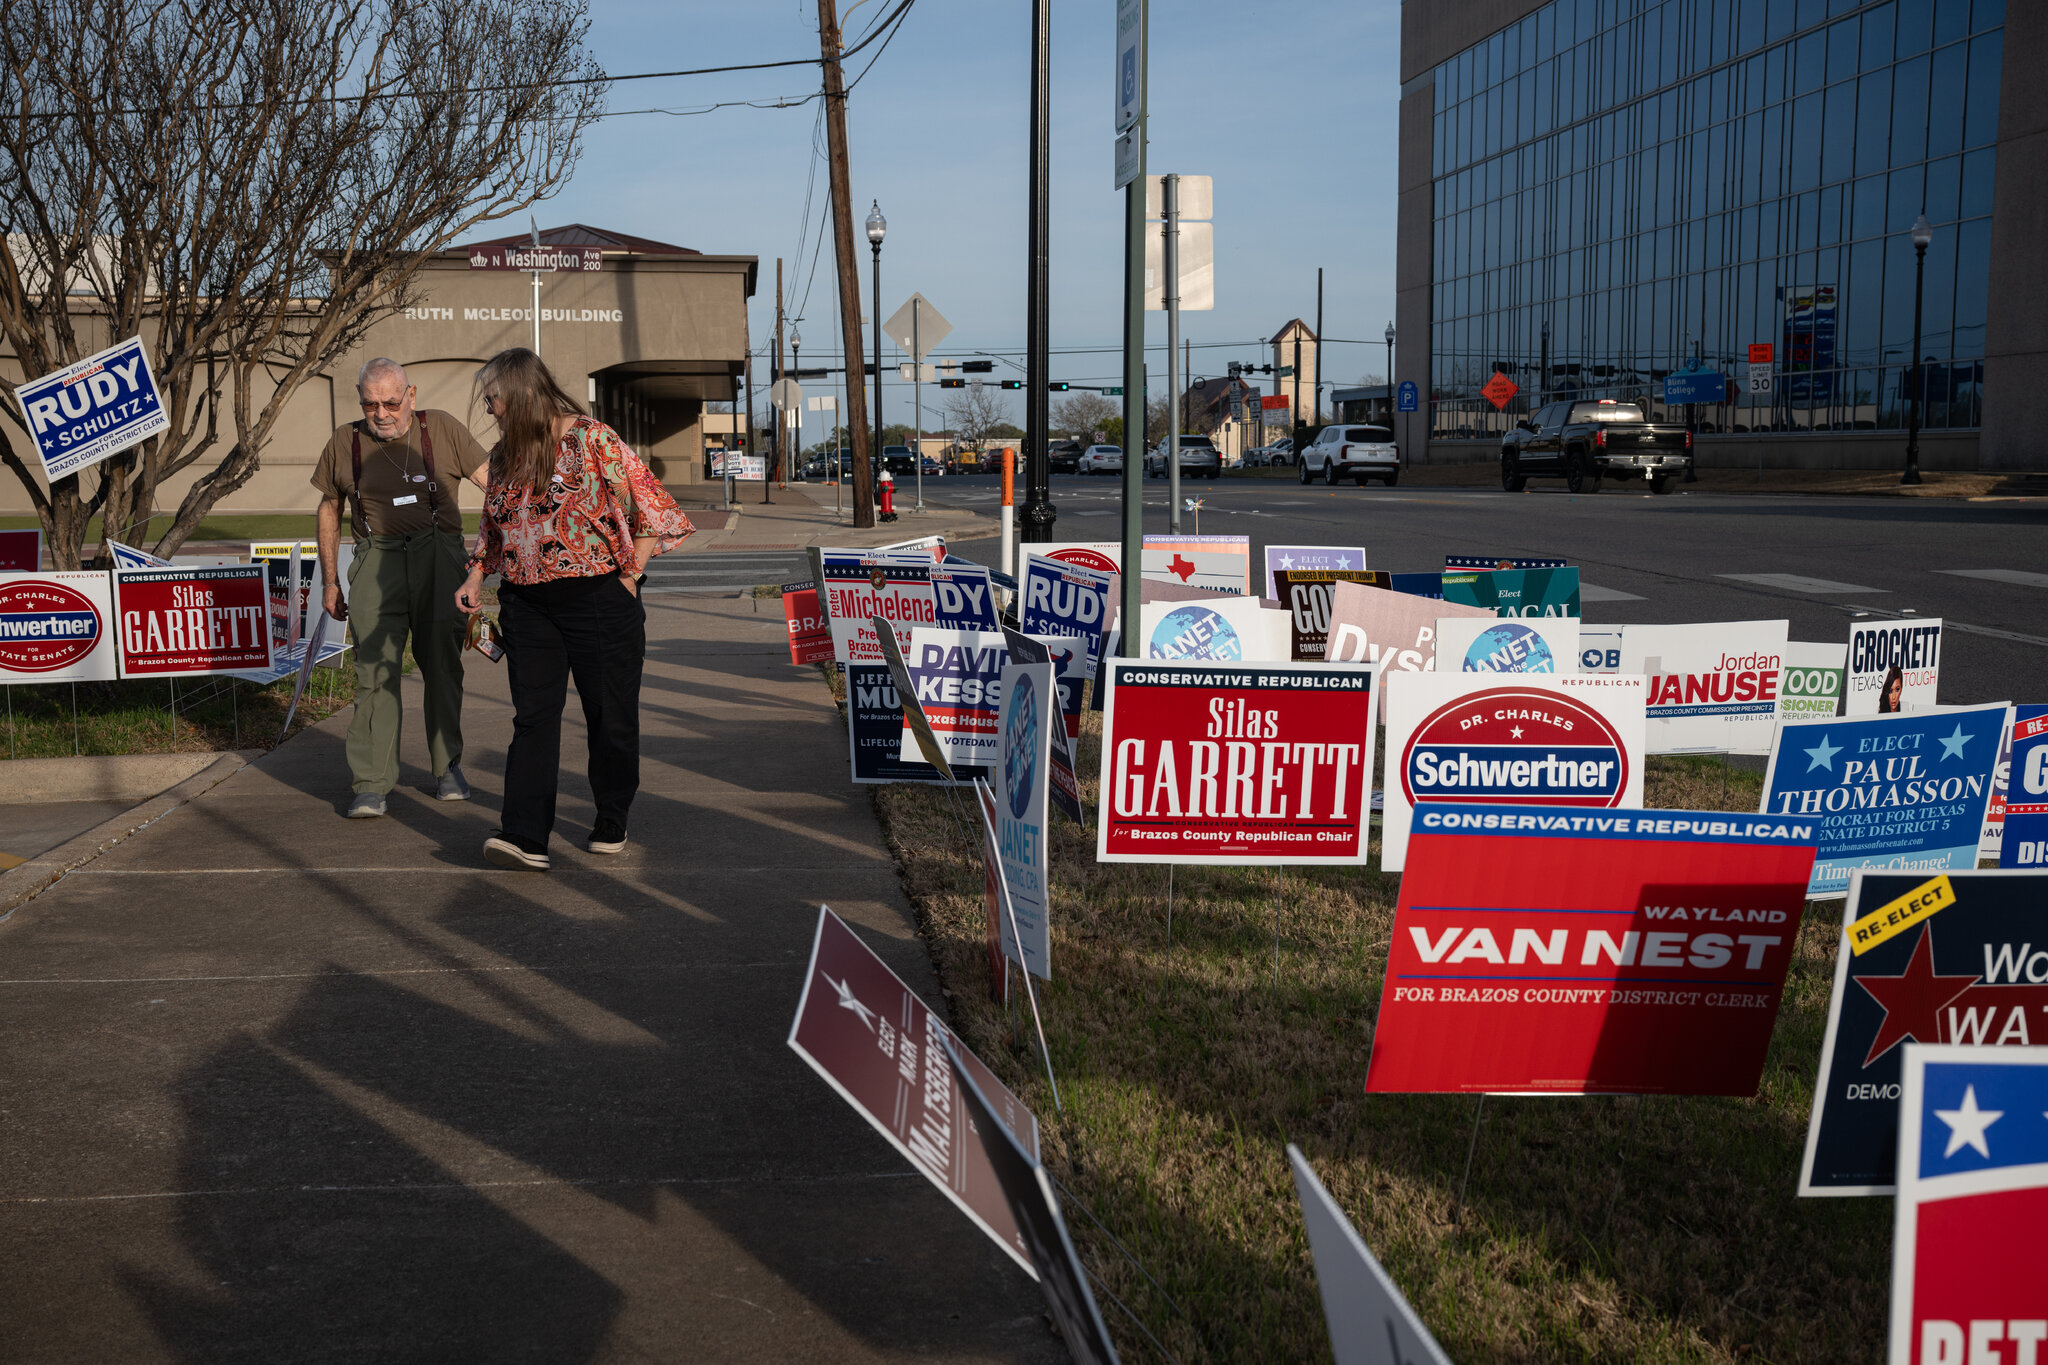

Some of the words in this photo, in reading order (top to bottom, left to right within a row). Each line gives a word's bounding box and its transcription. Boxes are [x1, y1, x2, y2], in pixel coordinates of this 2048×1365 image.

[493, 256, 500, 266] N
[505, 249, 580, 272] Washington
[584, 250, 600, 260] Ave
[583, 261, 601, 271] 200
[405, 308, 453, 320] RUTH
[464, 308, 534, 321] MCLEOD
[541, 309, 624, 322] BUILDING
[63, 364, 104, 386] REPUBLICAN
[70, 362, 93, 375] Elect
[1667, 378, 1687, 386] Blinn
[1667, 386, 1696, 395] College
[1752, 379, 1770, 390] 30
[27, 355, 141, 435] RUDY
[58, 398, 143, 447] SCHULTZ
[49, 457, 80, 475] BRAZOS
[80, 444, 110, 462] COUNTY
[110, 427, 142, 447] DISTRICT
[143, 415, 166, 431] CLERK
[98, 433, 115, 444] FOR
[1064, 557, 1099, 566] CHARLES
[122, 573, 196, 582] CONSERVATIVE
[198, 570, 259, 579] REPUBLICAN
[1061, 573, 1097, 588] REPUBLICAN
[1070, 567, 1088, 578] Elect
[1289, 571, 1318, 580] ENDORSED
[1318, 571, 1326, 580] BY
[1326, 571, 1355, 580] PRESIDENT
[1356, 572, 1373, 580] TRUMP
[15, 592, 66, 604] CHARLES
[172, 585, 215, 608] Silas
[934, 582, 986, 616] DY
[1498, 590, 1521, 598] Elect
[829, 588, 841, 618] Peter
[840, 589, 934, 623] Michelena
[124, 606, 262, 654] GARRETT
[906, 632, 911, 642] 4
[32, 645, 75, 661] SENATE
[848, 640, 883, 652] Brazos
[1197, 643, 1214, 656] the
[1852, 626, 1940, 673] CROCKETT
[138, 657, 166, 665] Brazos
[167, 657, 195, 665] County
[198, 654, 242, 663] Republican
[244, 653, 266, 661] Chair
[1714, 652, 1780, 672] Jordan
[1123, 672, 1252, 686] CONSERVATIVE
[1258, 675, 1363, 688] REPUBLICAN
[1562, 679, 1640, 687] REPUBLICAN
[1646, 671, 1778, 706] JANUSE
[1851, 675, 1883, 691] TEXAS
[1904, 670, 1936, 687] TOUGH
[1207, 697, 1279, 738] Silas
[1460, 714, 1488, 731] DR.
[1494, 709, 1575, 732] CHARLES
[1650, 707, 1673, 715] BRAZOS
[1724, 714, 1774, 722] REPUBLICAN
[1858, 733, 1925, 754] ELECT
[1114, 738, 1360, 820] GARRETT
[1415, 752, 1614, 787] Schwertner
[1841, 755, 1927, 785] PAUL
[1778, 774, 1987, 815] THOMASSON
[1885, 810, 1916, 823] FOR
[1919, 803, 1966, 819] TEXAS
[1113, 828, 1128, 838] for
[1131, 829, 1178, 840] Brazos
[1182, 830, 1231, 842] County
[1235, 830, 1312, 842] Republican
[1316, 831, 1353, 842] Chair
[1423, 813, 1630, 833] CONSERVATIVE
[1636, 818, 1812, 840] REPUBLICAN
[1868, 820, 1939, 837] DISTRICT
[1941, 819, 1951, 830] 5
[1000, 817, 1039, 867] JANET
[1643, 905, 1787, 924] WAYLAND
[1856, 886, 1943, 943] RE-ELECT
[1408, 926, 1569, 965] VAN
[1580, 930, 1781, 970] NEST
[1394, 987, 1436, 1002] FOR
[1438, 987, 1519, 1003] BRAZOS
[1523, 988, 1606, 1004] COUNTY
[1610, 989, 1702, 1006] DISTRICT
[1704, 992, 1768, 1009] CLERK
[878, 1016, 897, 1059] ELECT
[899, 1032, 918, 1087] MARK
